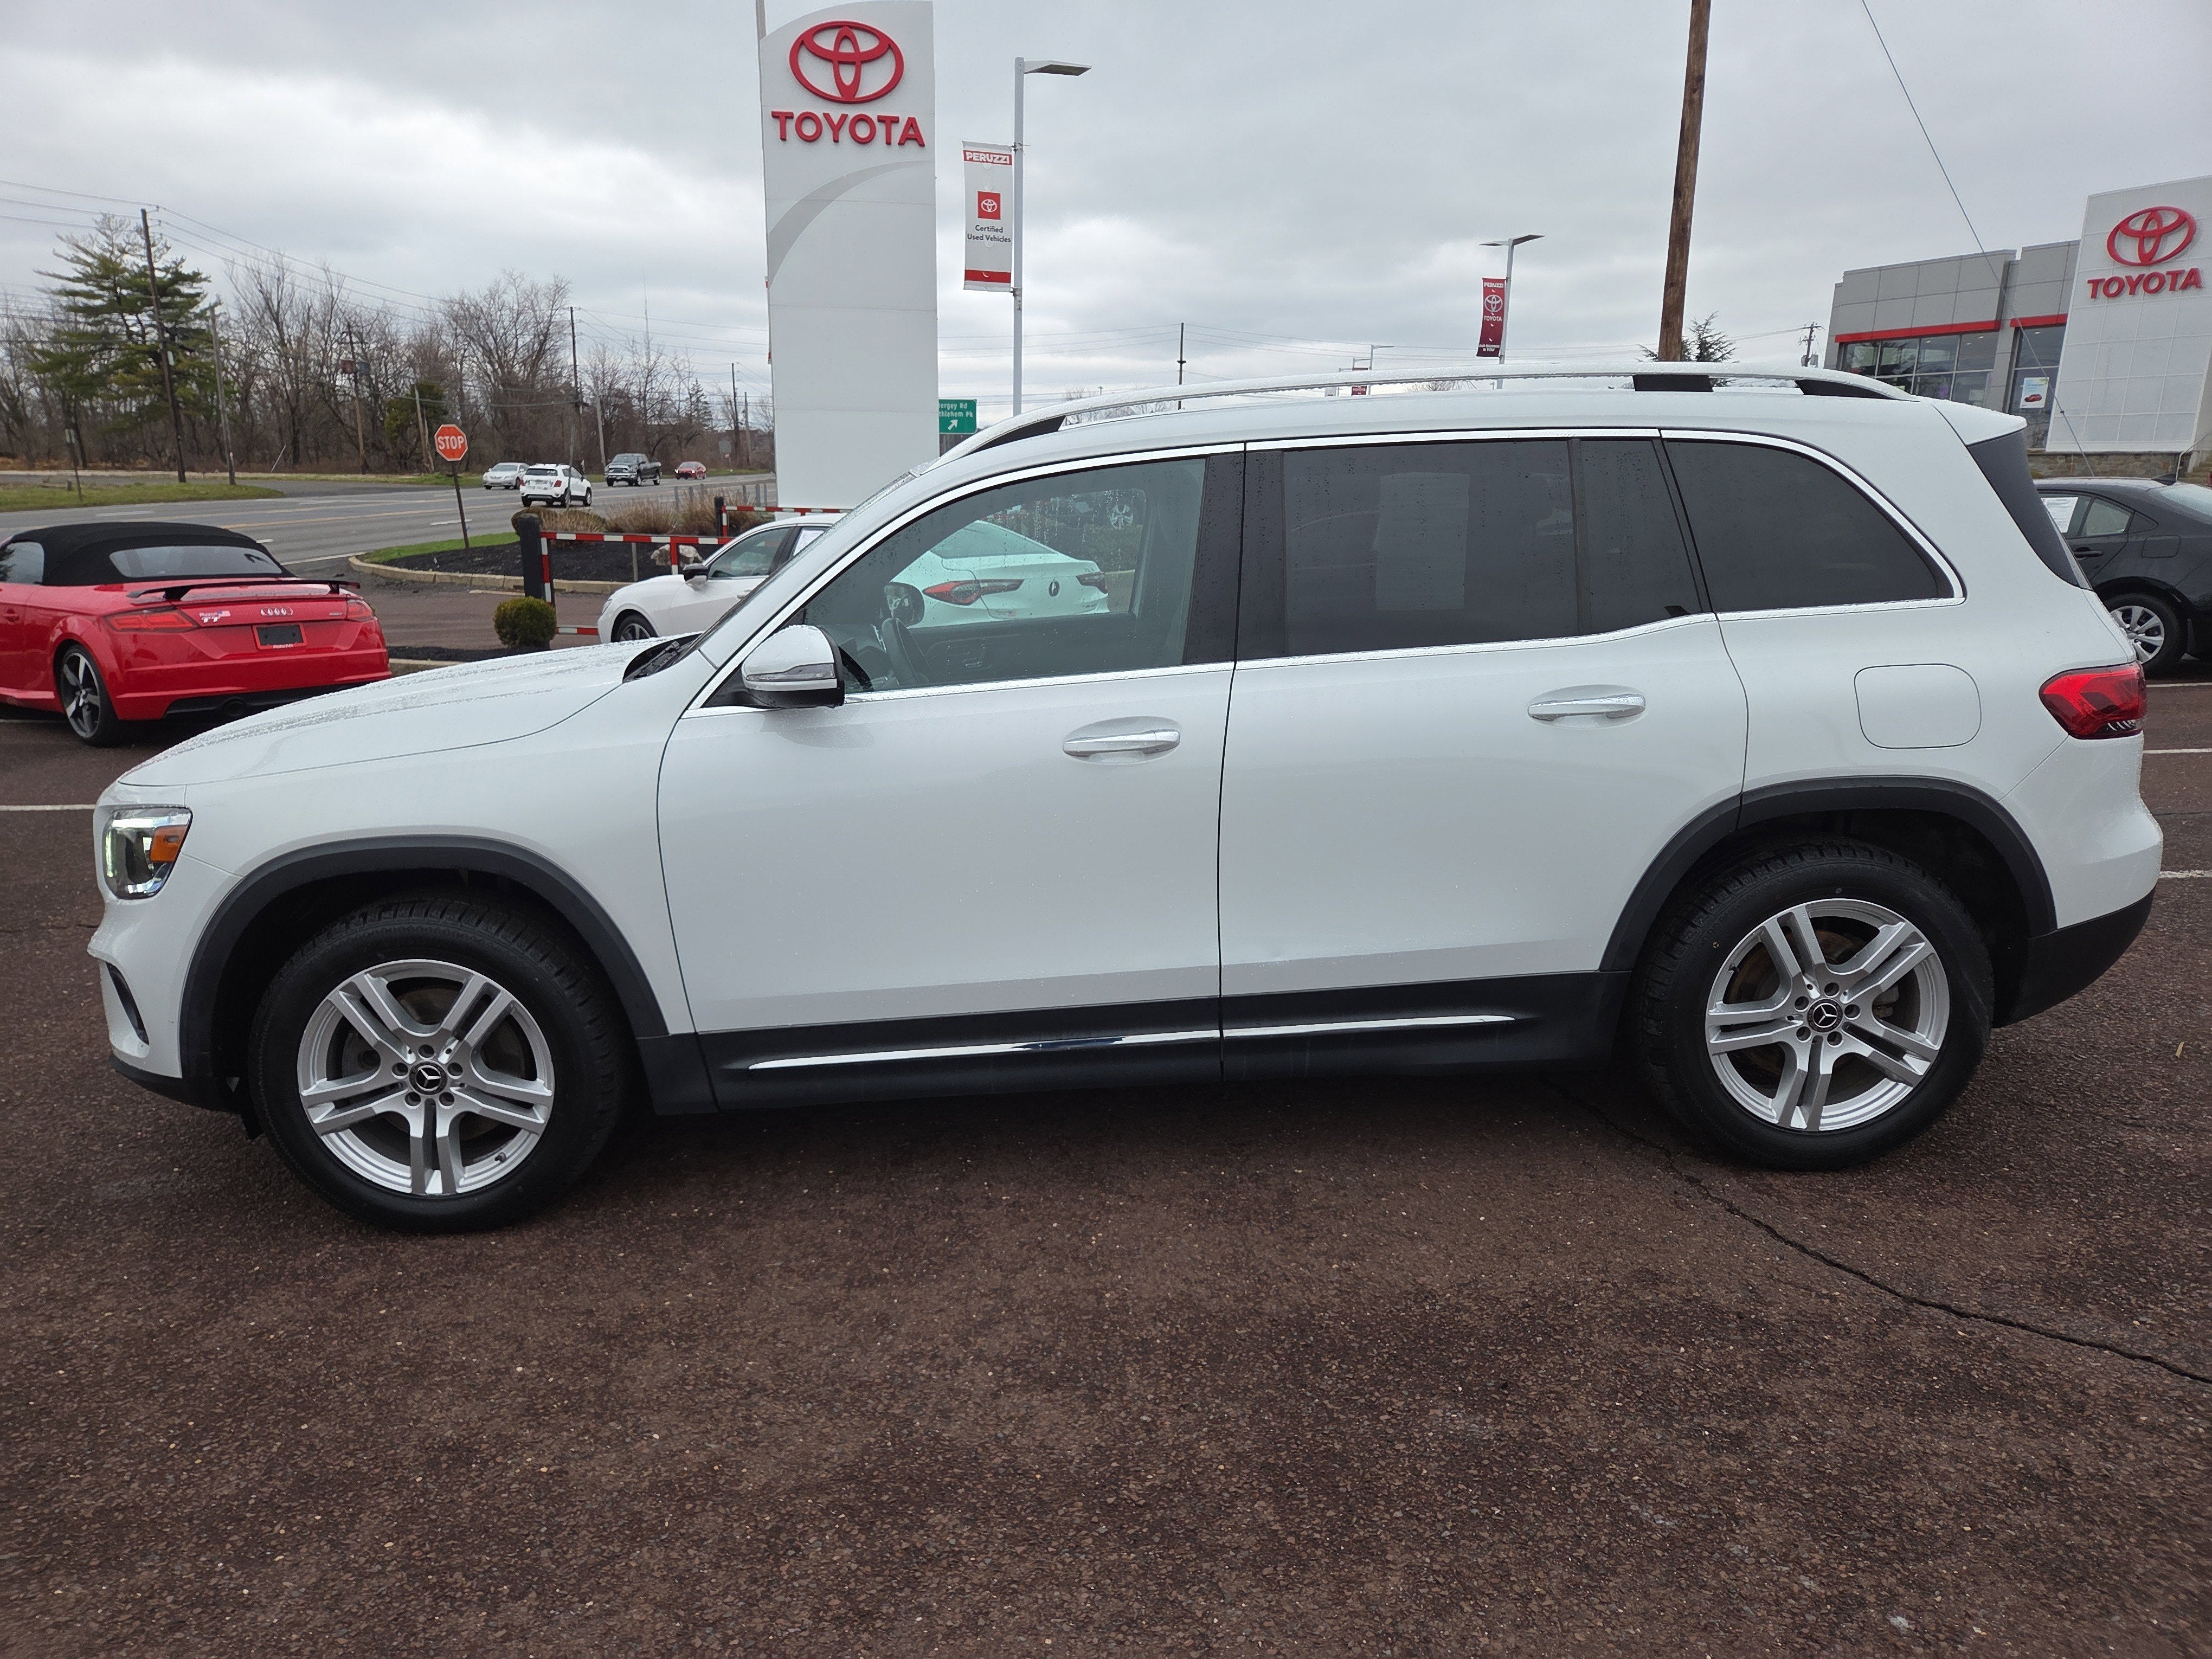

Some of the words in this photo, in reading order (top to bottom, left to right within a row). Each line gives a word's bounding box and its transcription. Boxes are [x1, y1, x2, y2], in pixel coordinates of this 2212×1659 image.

[771, 111, 925, 147] TOYOTA
[965, 152, 1010, 164] PERUZZI
[975, 224, 1004, 233] Certified
[985, 234, 1011, 243] Vehicles
[2087, 267, 2203, 299] TOYOTA
[438, 435, 465, 450] STOP
